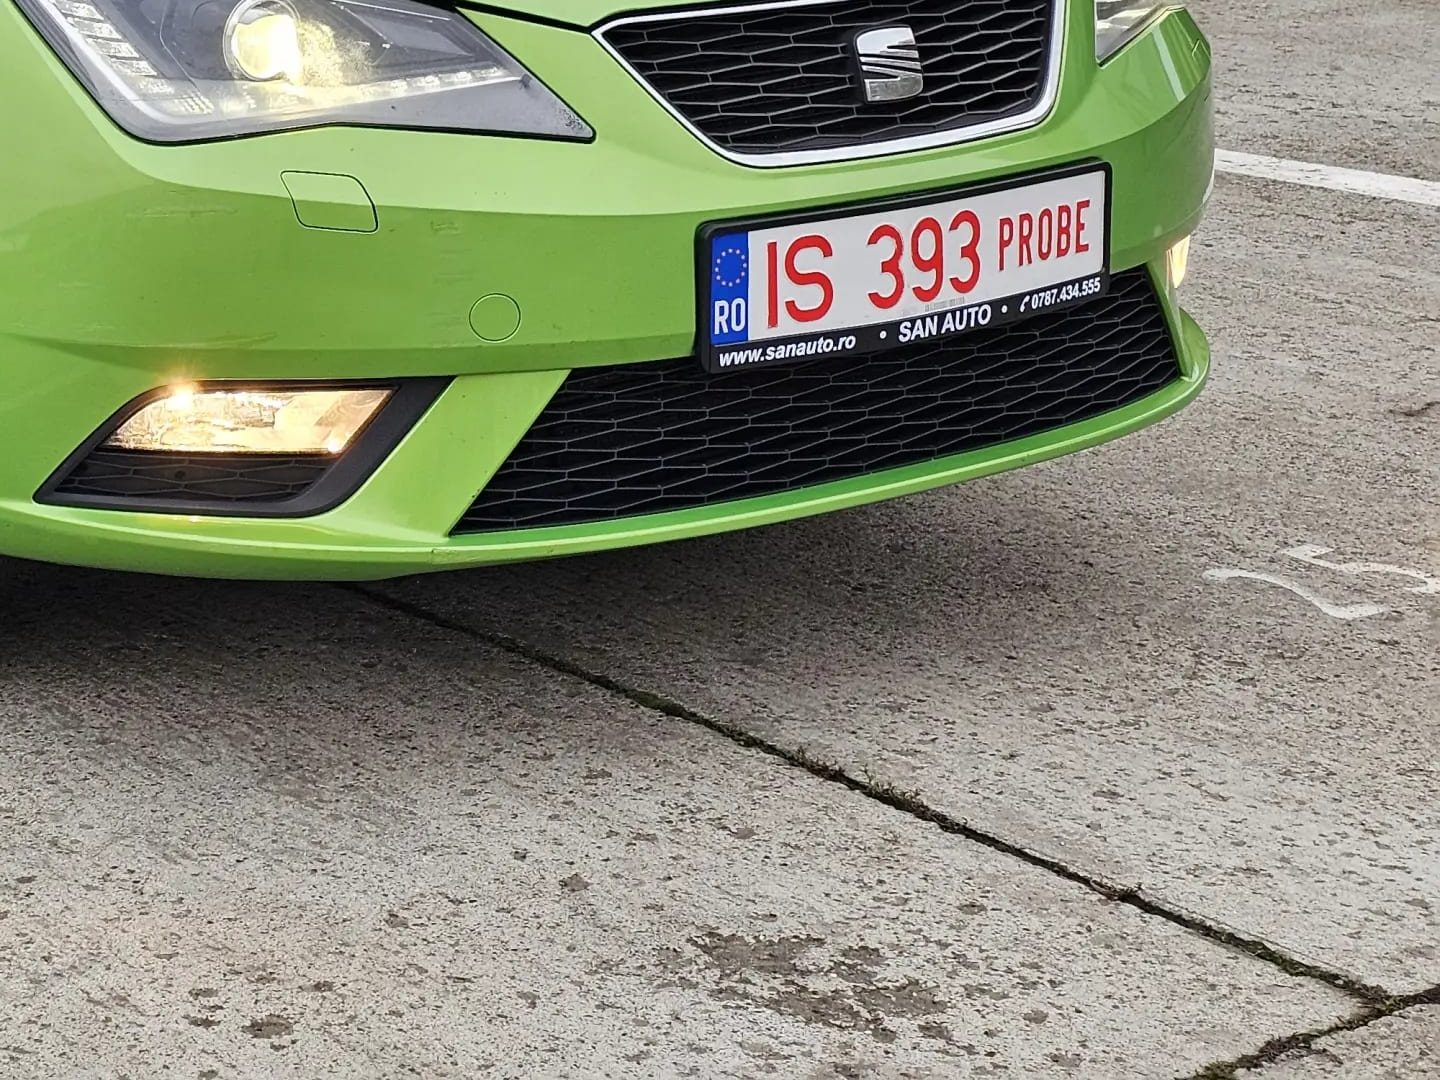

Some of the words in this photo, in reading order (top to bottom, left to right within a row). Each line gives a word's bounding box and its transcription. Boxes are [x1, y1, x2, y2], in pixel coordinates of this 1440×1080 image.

[767, 234, 834, 328] IS
[867, 209, 981, 309] 393
[999, 199, 1090, 272] PROBE
[714, 297, 746, 335] RO
[719, 332, 856, 367] www.sanauto.ro
[898, 319, 938, 343] SAN
[941, 304, 992, 336] AUTO
[1031, 277, 1101, 310] 0787.434.555
